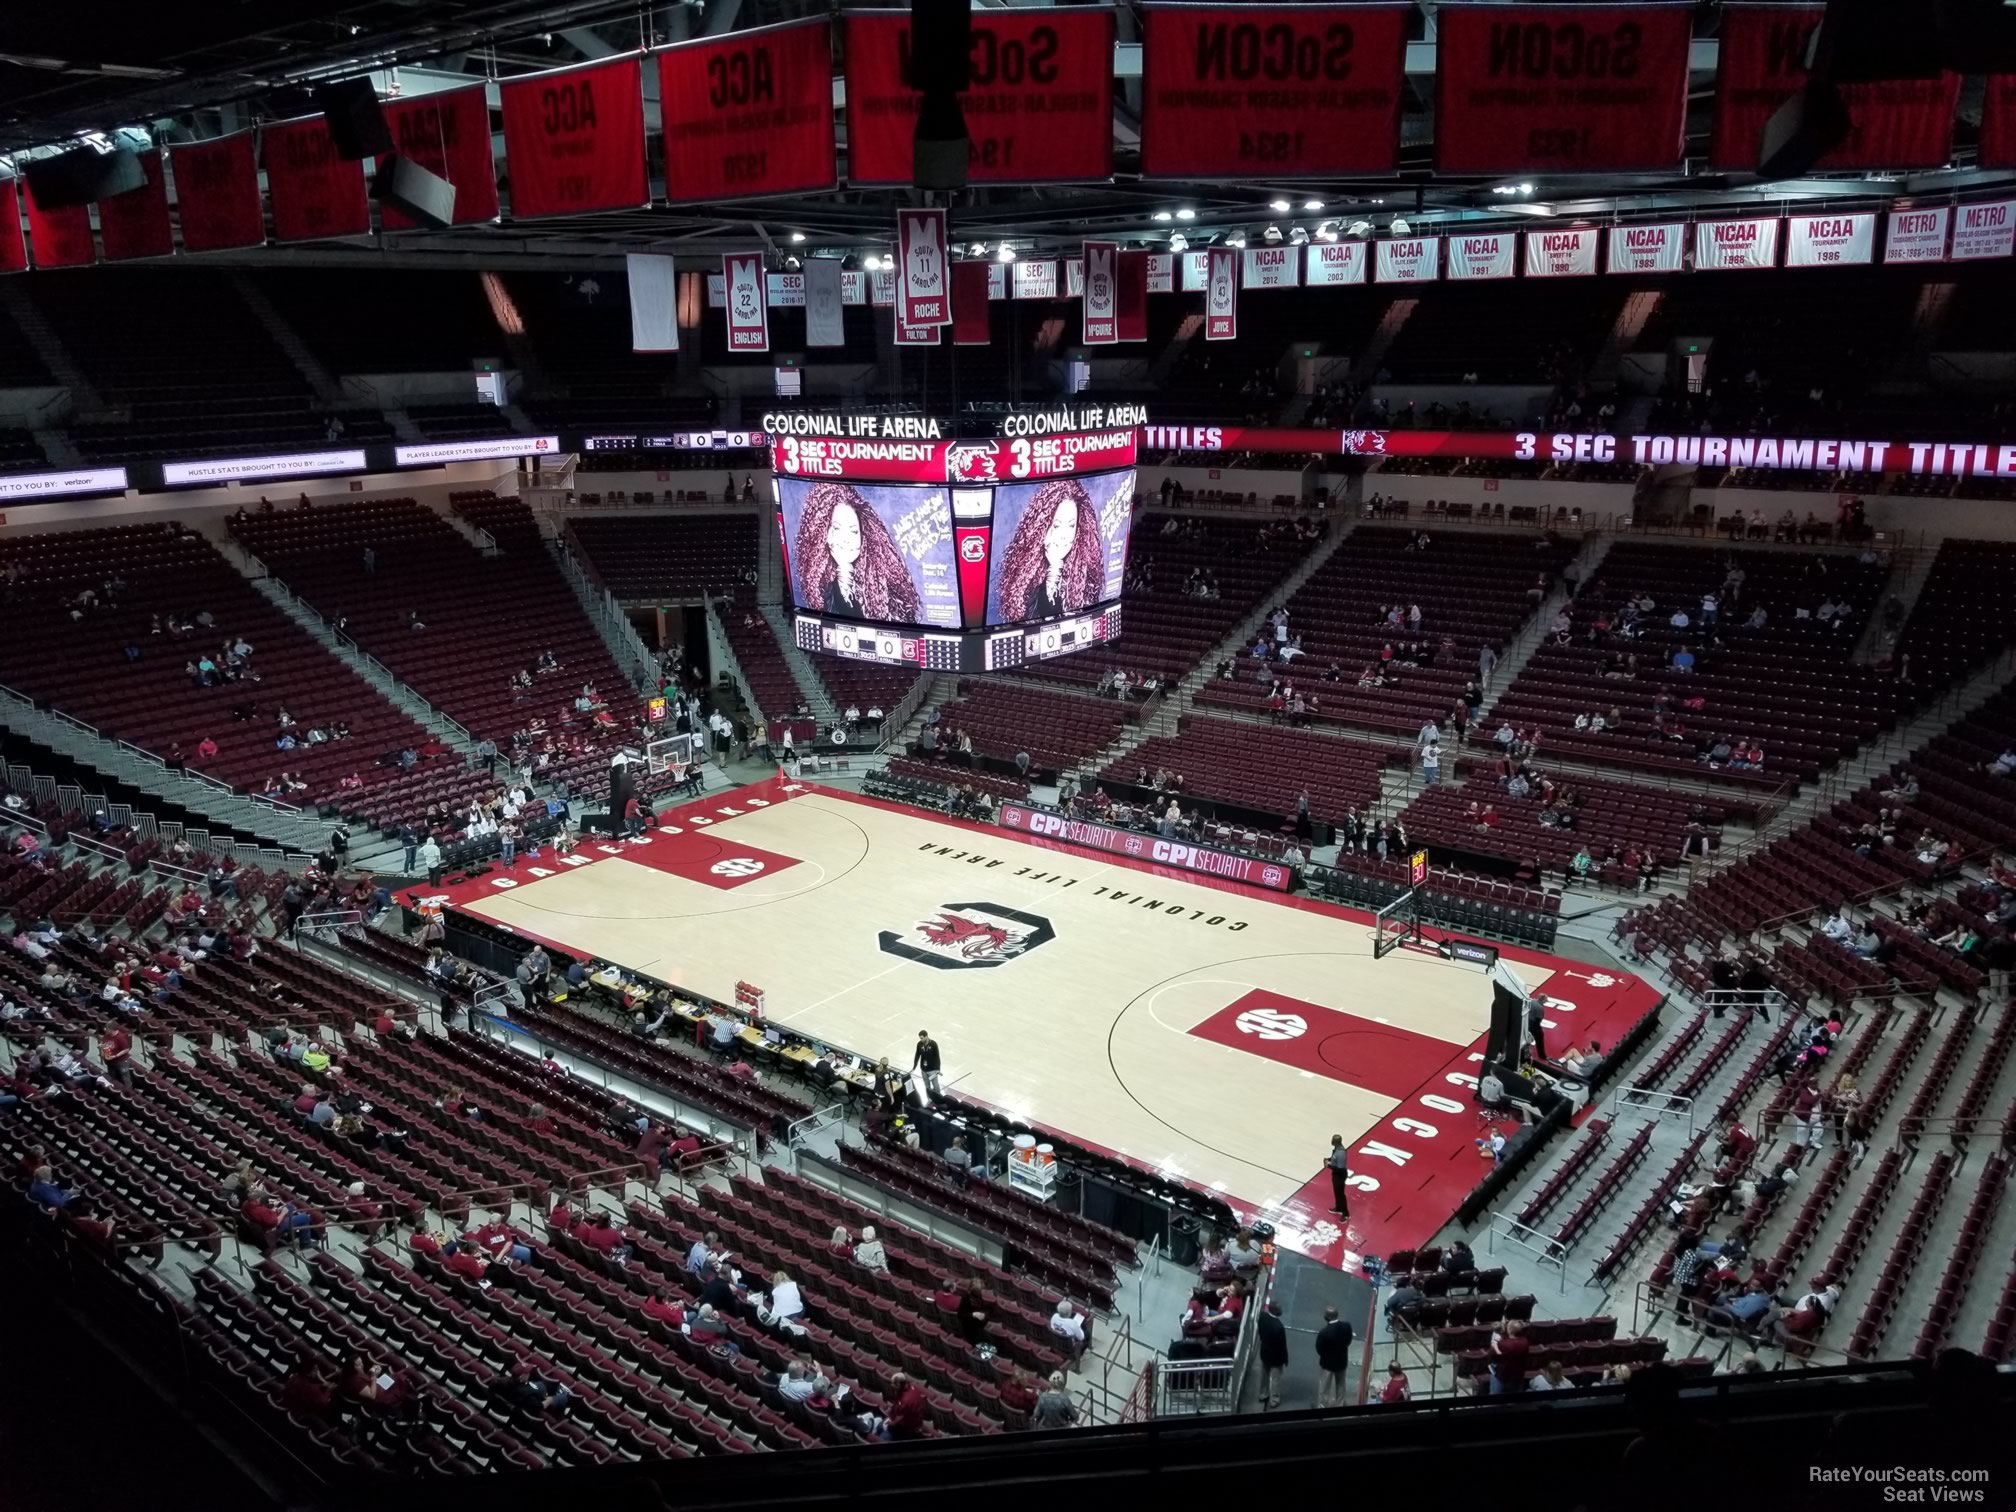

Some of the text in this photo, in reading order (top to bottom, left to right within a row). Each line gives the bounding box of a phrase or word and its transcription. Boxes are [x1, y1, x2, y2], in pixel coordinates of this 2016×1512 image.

[1898, 213, 1936, 234] METRO
[1966, 206, 2006, 228] METRO
[1714, 224, 1756, 242] NCAA
[1808, 219, 1853, 238] NCAA
[1543, 234, 1579, 251] NCAA
[1626, 229, 1665, 246] NCAA
[914, 245, 934, 257] SOUTH
[1321, 246, 1352, 262] NCAA
[1390, 242, 1423, 258] NCAA
[1464, 238, 1499, 255] NCAA
[1195, 255, 1208, 269] NC
[1256, 250, 1285, 266] NCAA
[1817, 251, 1840, 261] 1986
[920, 258, 930, 273] 11
[1026, 264, 1043, 278] SEC
[1147, 258, 1157, 272] EC
[1472, 266, 1489, 275] 1991
[911, 272, 939, 288] CAROLINA
[1262, 276, 1278, 285] 2012
[1327, 273, 1344, 281] 2003
[1397, 269, 1415, 278] 2002
[736, 283, 754, 294] SOUTH
[783, 276, 801, 289] SEC
[841, 274, 856, 289] CAA
[1094, 284, 1107, 298] 550
[741, 294, 752, 307] 22
[1090, 297, 1111, 311] CAROLINA
[735, 306, 758, 320] CAROLINA
[914, 303, 940, 318] ROCHE
[1213, 321, 1229, 333] JOYCE
[734, 332, 763, 344] ENGLISH
[906, 330, 928, 340] FULTON
[763, 414, 941, 439] COLONIAL LIFE ARENA
[1004, 405, 1148, 437] COLONIAL LIFE ARENA
[1033, 431, 1133, 457] SEC TOURNAMENT
[1145, 426, 1222, 450] TITLES
[431, 449, 454, 457] LEADER
[455, 448, 473, 456] STATS
[474, 446, 501, 455] BROUGHT
[783, 436, 800, 474] 3
[800, 442, 935, 461] SEC TOURNAMENT
[1010, 438, 1031, 478] 3
[1515, 432, 1536, 460] 3
[1552, 434, 1616, 463] SEC
[1632, 435, 1890, 472] TOURNAMENT
[188, 467, 216, 476] HUSTLE
[217, 466, 240, 475] STATS
[241, 463, 275, 473] BROUGHT
[288, 461, 303, 469] YOU
[801, 457, 843, 475] TITLES
[1033, 455, 1075, 473] TITLES
[24, 482, 42, 490] YOU
[44, 481, 58, 490] BY:
[1081, 626, 1087, 640] 0
[843, 635, 852, 648] 0
[884, 641, 894, 654] 0
[1047, 635, 1055, 648] 0
[652, 706, 664, 718] 30
[1068, 821, 1118, 848] SECURITY
[918, 842, 1004, 868] ARENA
[1152, 840, 1252, 879] CPI SECURITY
[1012, 867, 1079, 888] LIFE
[1264, 871, 1280, 880] CPI
[1414, 863, 1424, 882] 30
[1092, 886, 1250, 932] COLONIAL
[1456, 947, 1487, 960] verizon
